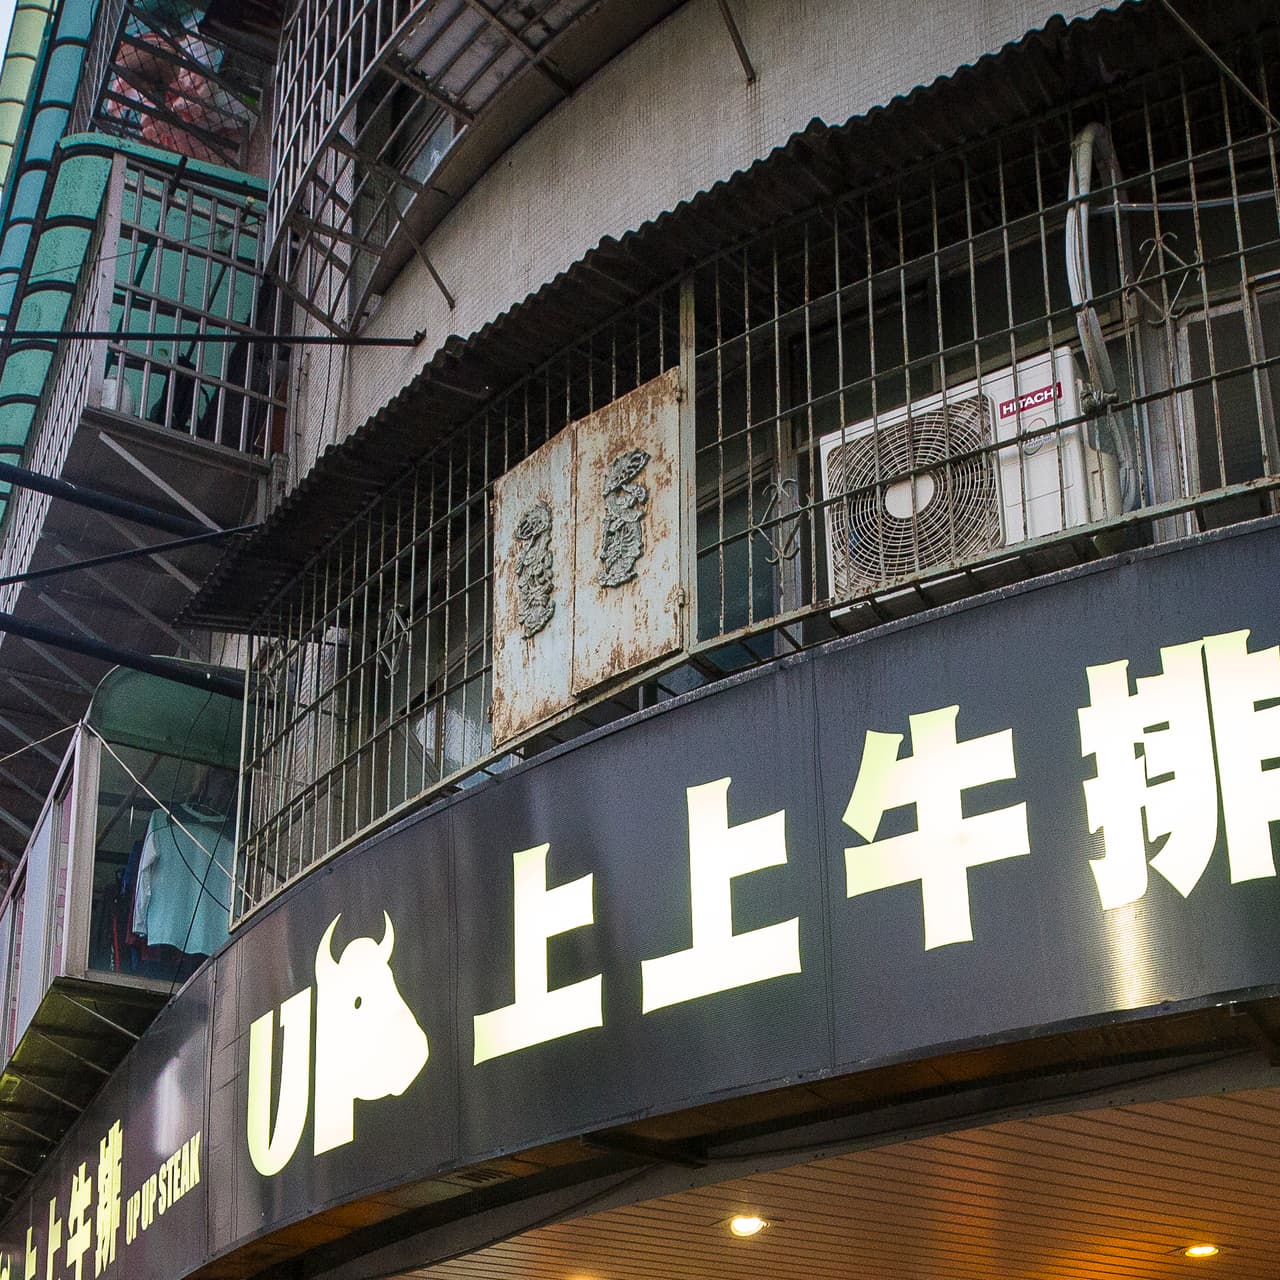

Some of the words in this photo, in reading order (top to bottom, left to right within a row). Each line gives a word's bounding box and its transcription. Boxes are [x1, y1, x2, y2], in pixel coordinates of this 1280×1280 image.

[125, 1189, 141, 1246] UP
[140, 1172, 157, 1231] UP
[157, 1130, 201, 1216] STEAK
